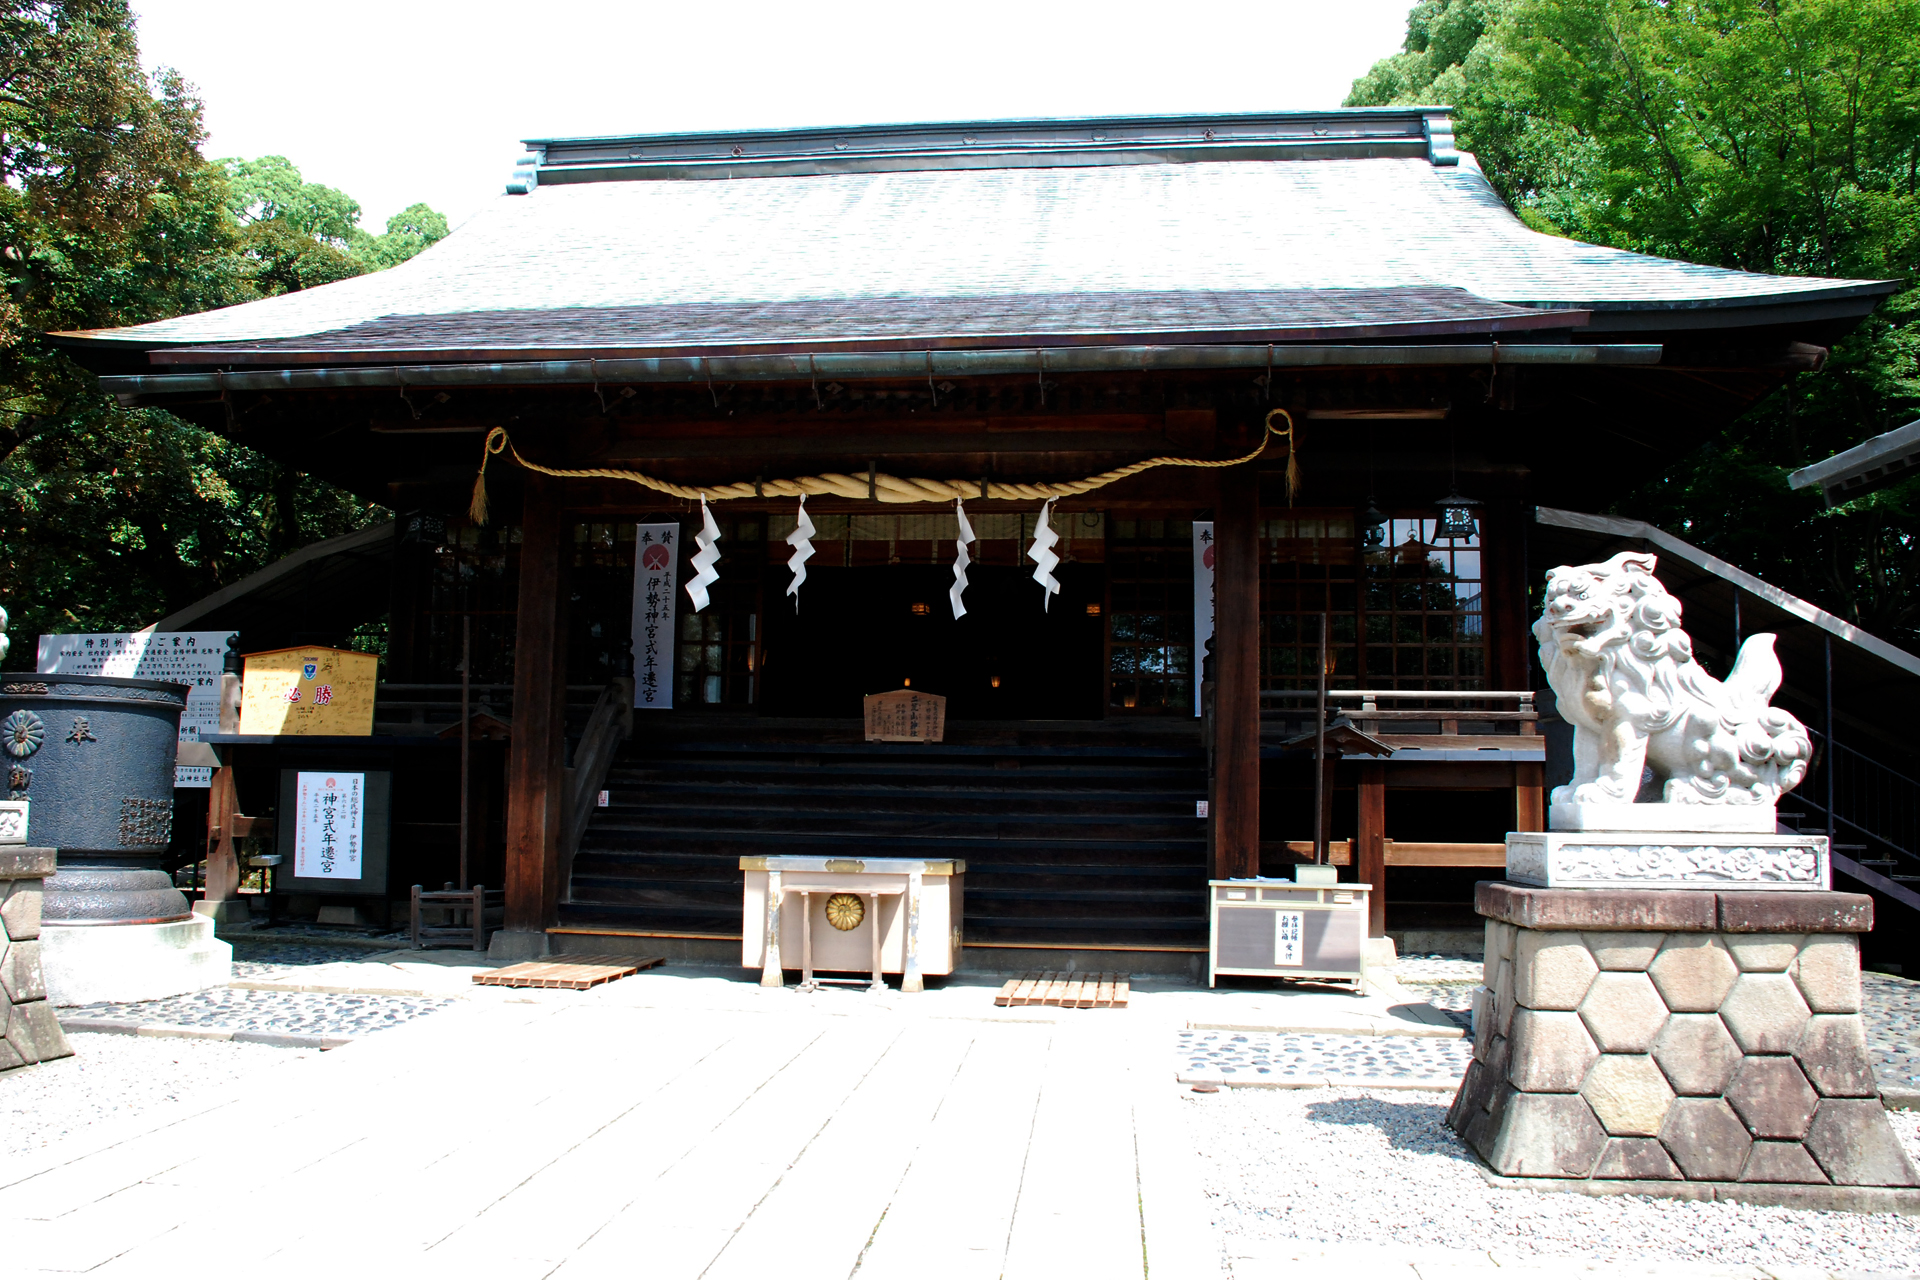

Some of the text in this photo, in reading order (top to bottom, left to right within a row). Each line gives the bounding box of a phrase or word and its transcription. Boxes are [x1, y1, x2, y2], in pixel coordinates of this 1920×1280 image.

[661, 571, 672, 621] 平成二十五年
[642, 577, 661, 703] 伊勢神宮式年遷宮
[320, 792, 337, 873] 神宮式年遷宮
